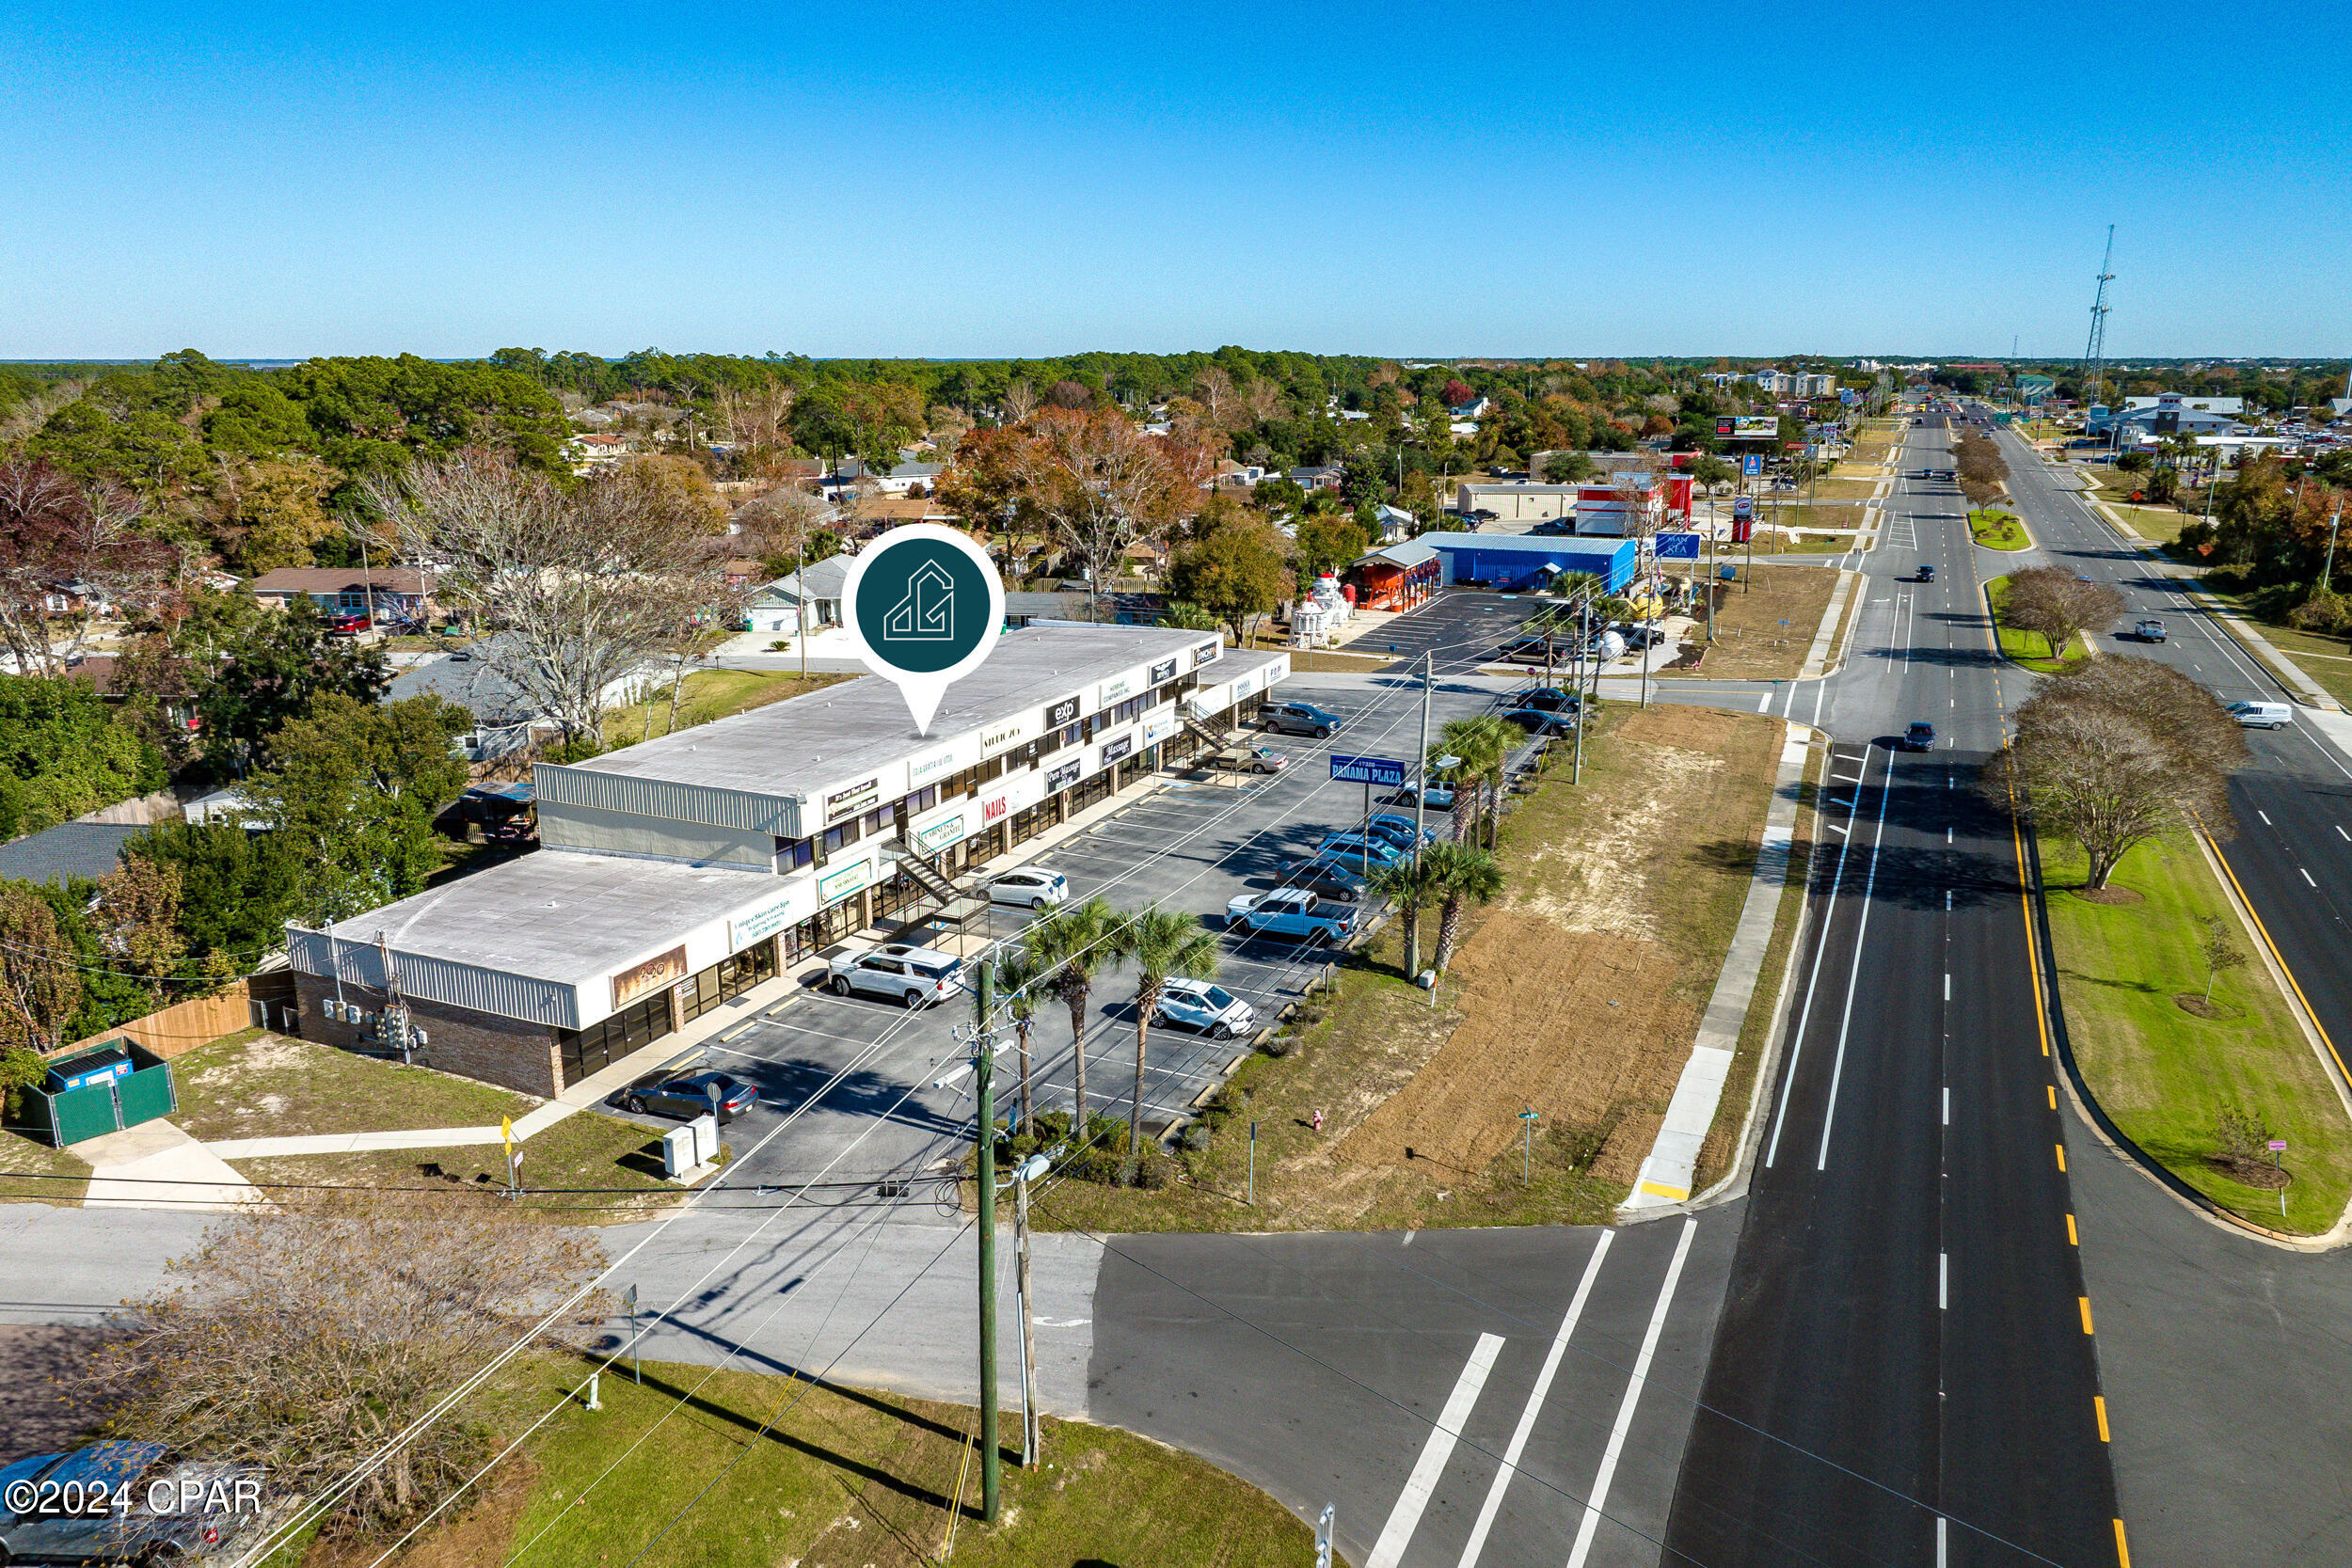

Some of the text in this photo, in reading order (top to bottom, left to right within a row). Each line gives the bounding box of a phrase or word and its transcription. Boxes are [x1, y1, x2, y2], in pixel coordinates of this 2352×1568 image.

[1332, 764, 1401, 784] PANAMA PLAZA
[985, 796, 1007, 821] NAILS
[779, 899, 790, 911] Spa
